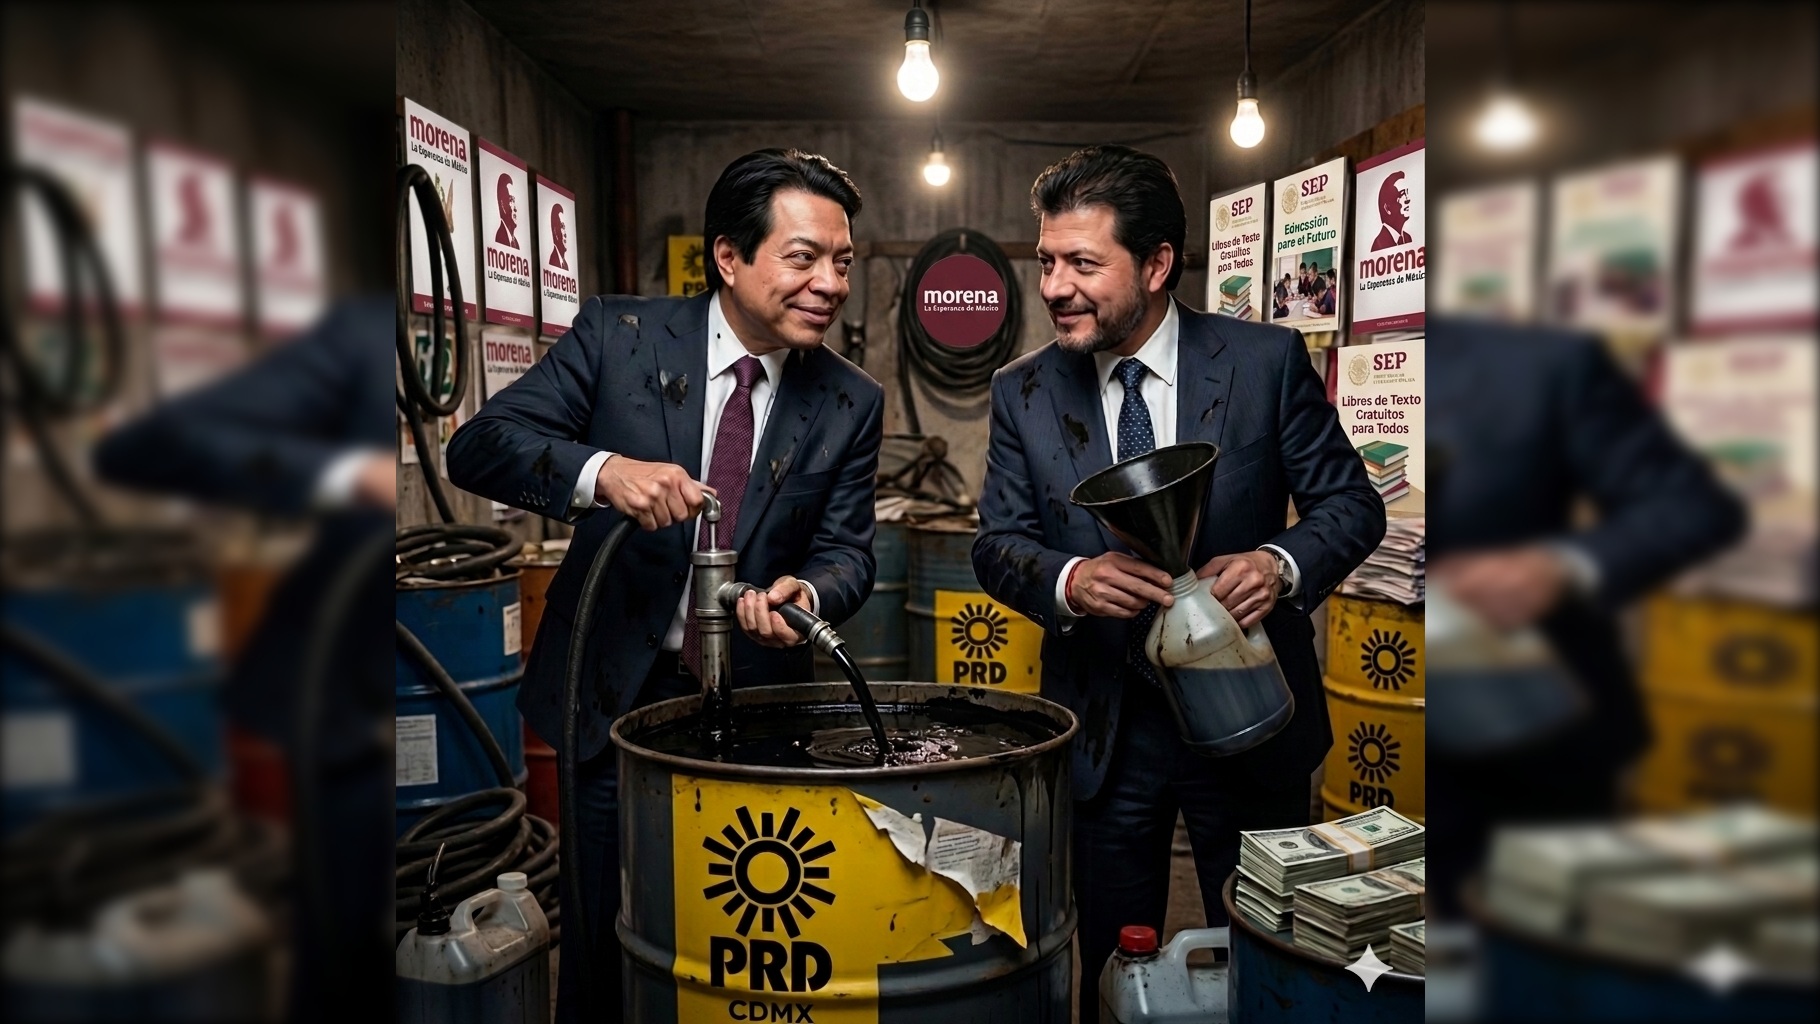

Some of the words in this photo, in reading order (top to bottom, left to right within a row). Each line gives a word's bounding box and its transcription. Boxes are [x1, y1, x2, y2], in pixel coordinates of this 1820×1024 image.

[410, 114, 467, 162] morena
[1301, 174, 1329, 197] SEP
[1231, 197, 1253, 217] SEP
[1232, 236, 1240, 246] de
[1307, 229, 1337, 244] Futuro
[487, 247, 530, 278] morena
[1360, 246, 1425, 279] morena
[543, 268, 577, 294] morena
[1397, 275, 1404, 284] de
[924, 290, 999, 304] morena
[486, 342, 532, 364] morena
[1373, 351, 1407, 371] SEP
[1342, 395, 1372, 407] Libres
[1374, 395, 1388, 406] de
[1390, 394, 1421, 405] Texto
[1352, 424, 1374, 436] para
[1377, 422, 1409, 434] Todos
[953, 660, 1007, 685] PRD
[1350, 780, 1395, 810] PRD
[710, 935, 833, 993] PRD
[728, 1000, 814, 1024] CDMX
